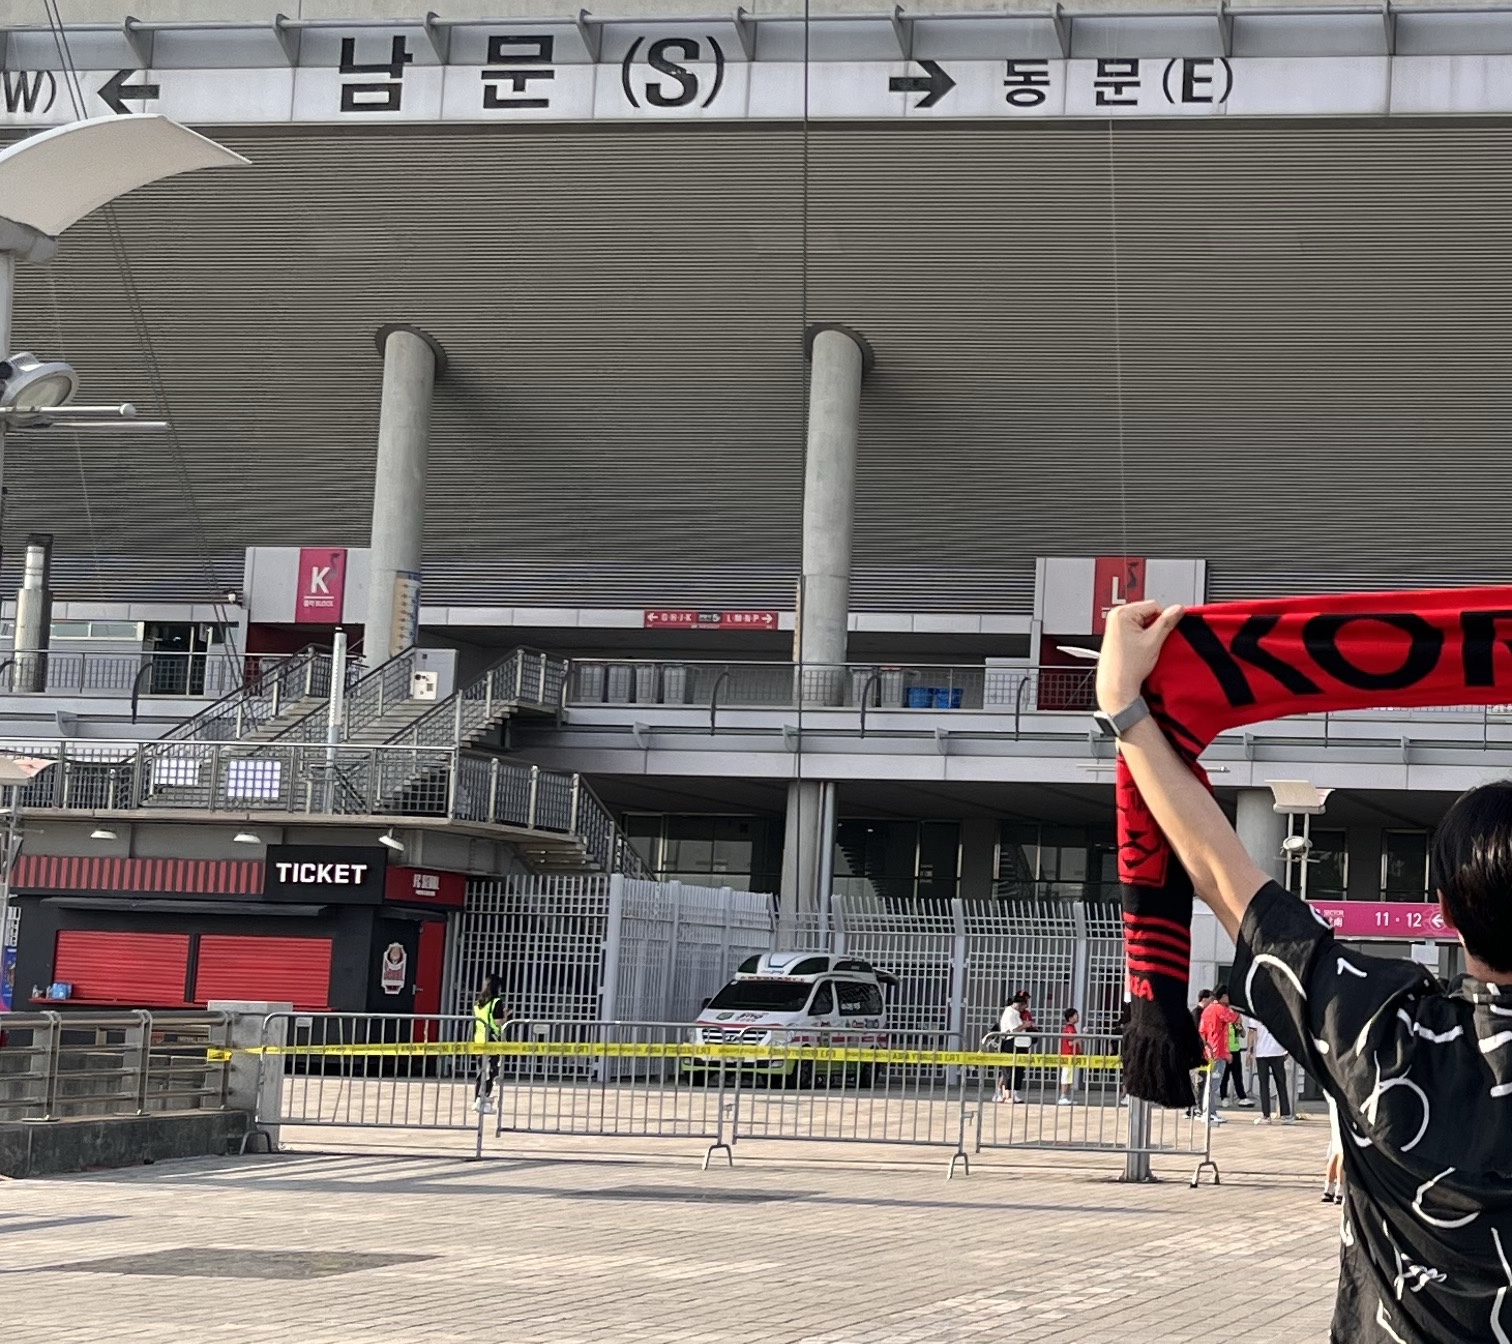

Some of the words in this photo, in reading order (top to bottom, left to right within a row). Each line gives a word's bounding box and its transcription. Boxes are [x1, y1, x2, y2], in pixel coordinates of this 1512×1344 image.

[311, 566, 330, 594] K
[1111, 576, 1127, 605] L
[275, 861, 368, 884] TICKET
